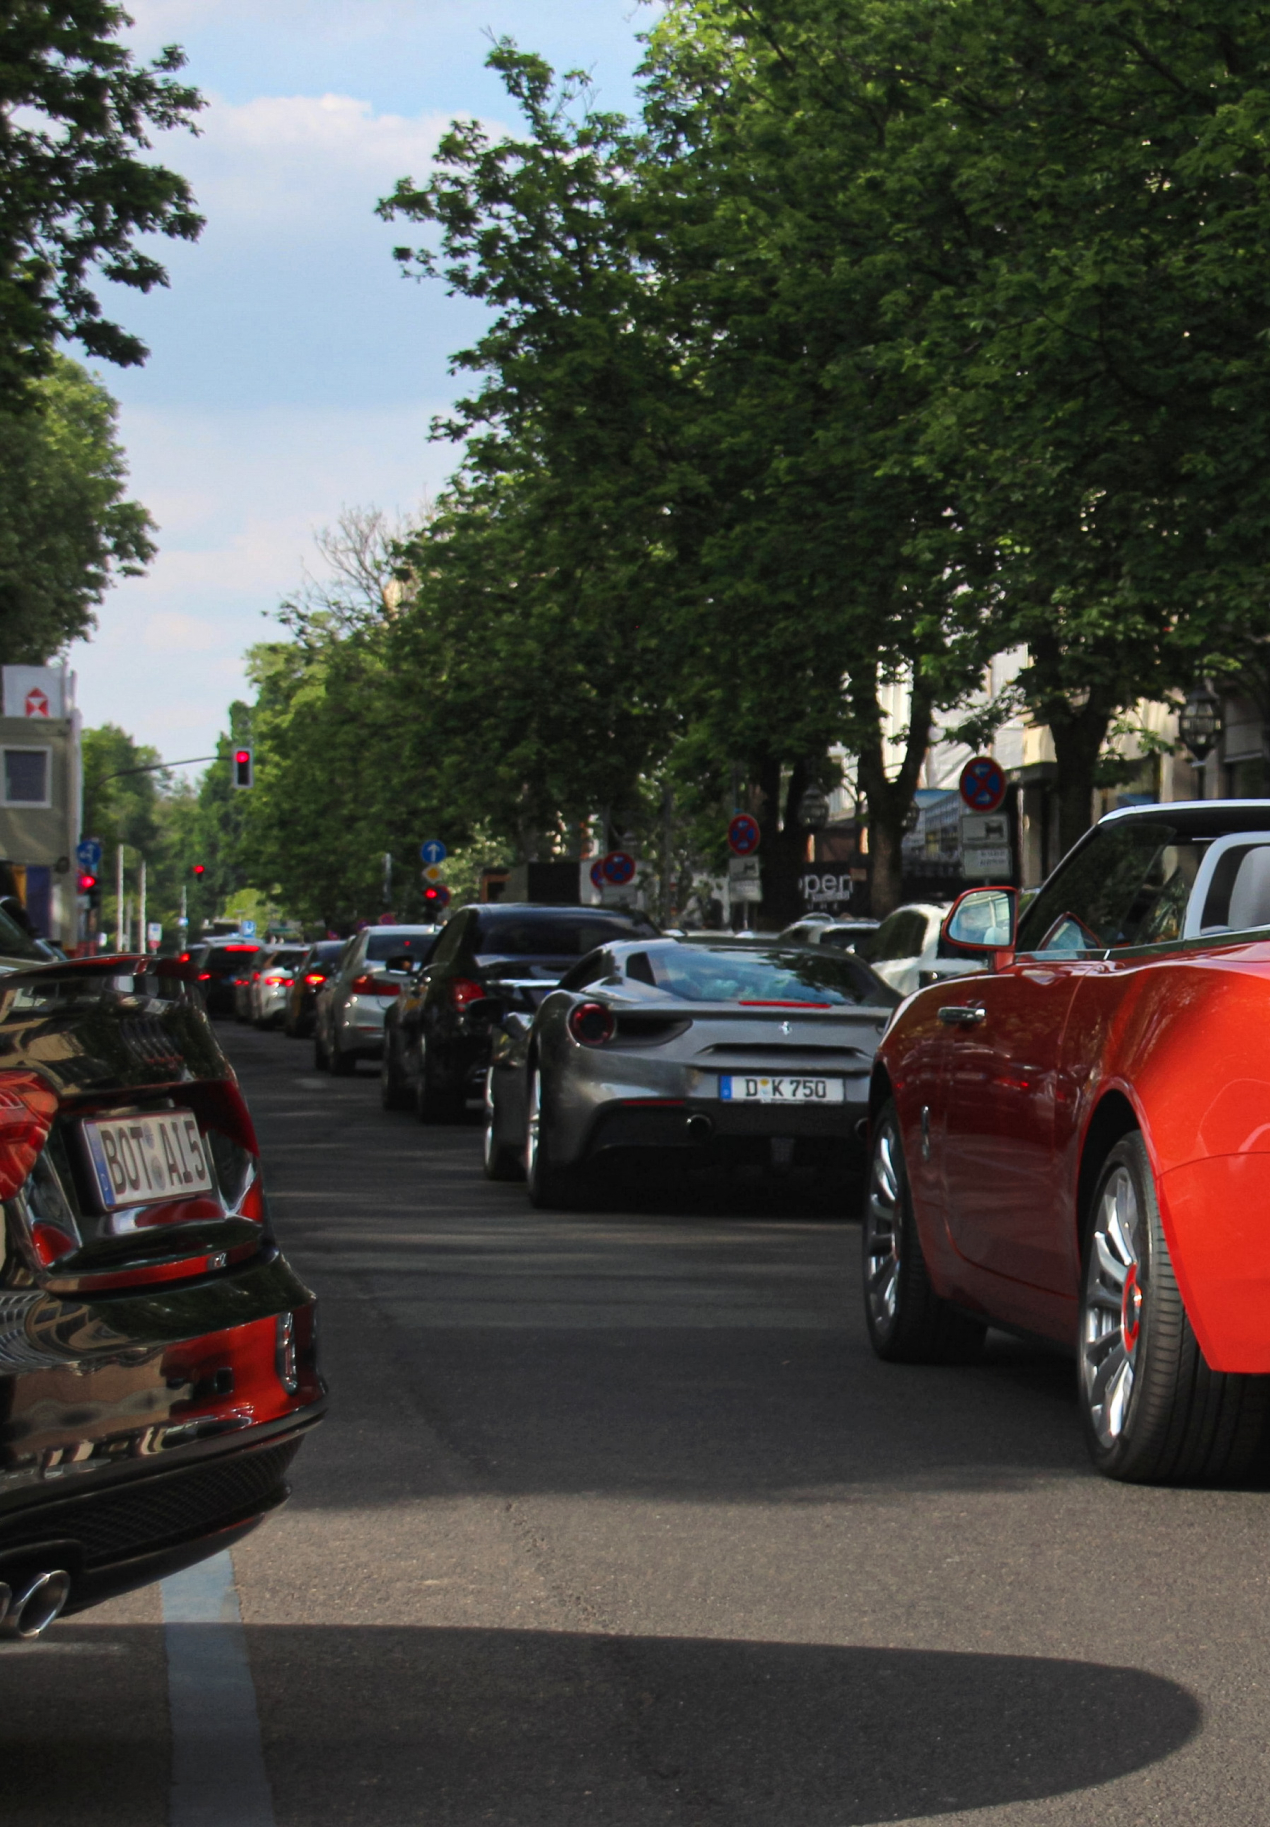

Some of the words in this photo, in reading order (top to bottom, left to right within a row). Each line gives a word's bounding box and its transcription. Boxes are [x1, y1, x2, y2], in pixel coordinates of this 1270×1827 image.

[745, 1078, 758, 1097] D
[771, 1078, 784, 1097] K
[789, 1079, 826, 1099] 750
[101, 1126, 153, 1195] BOT
[184, 1120, 206, 1181] 5
